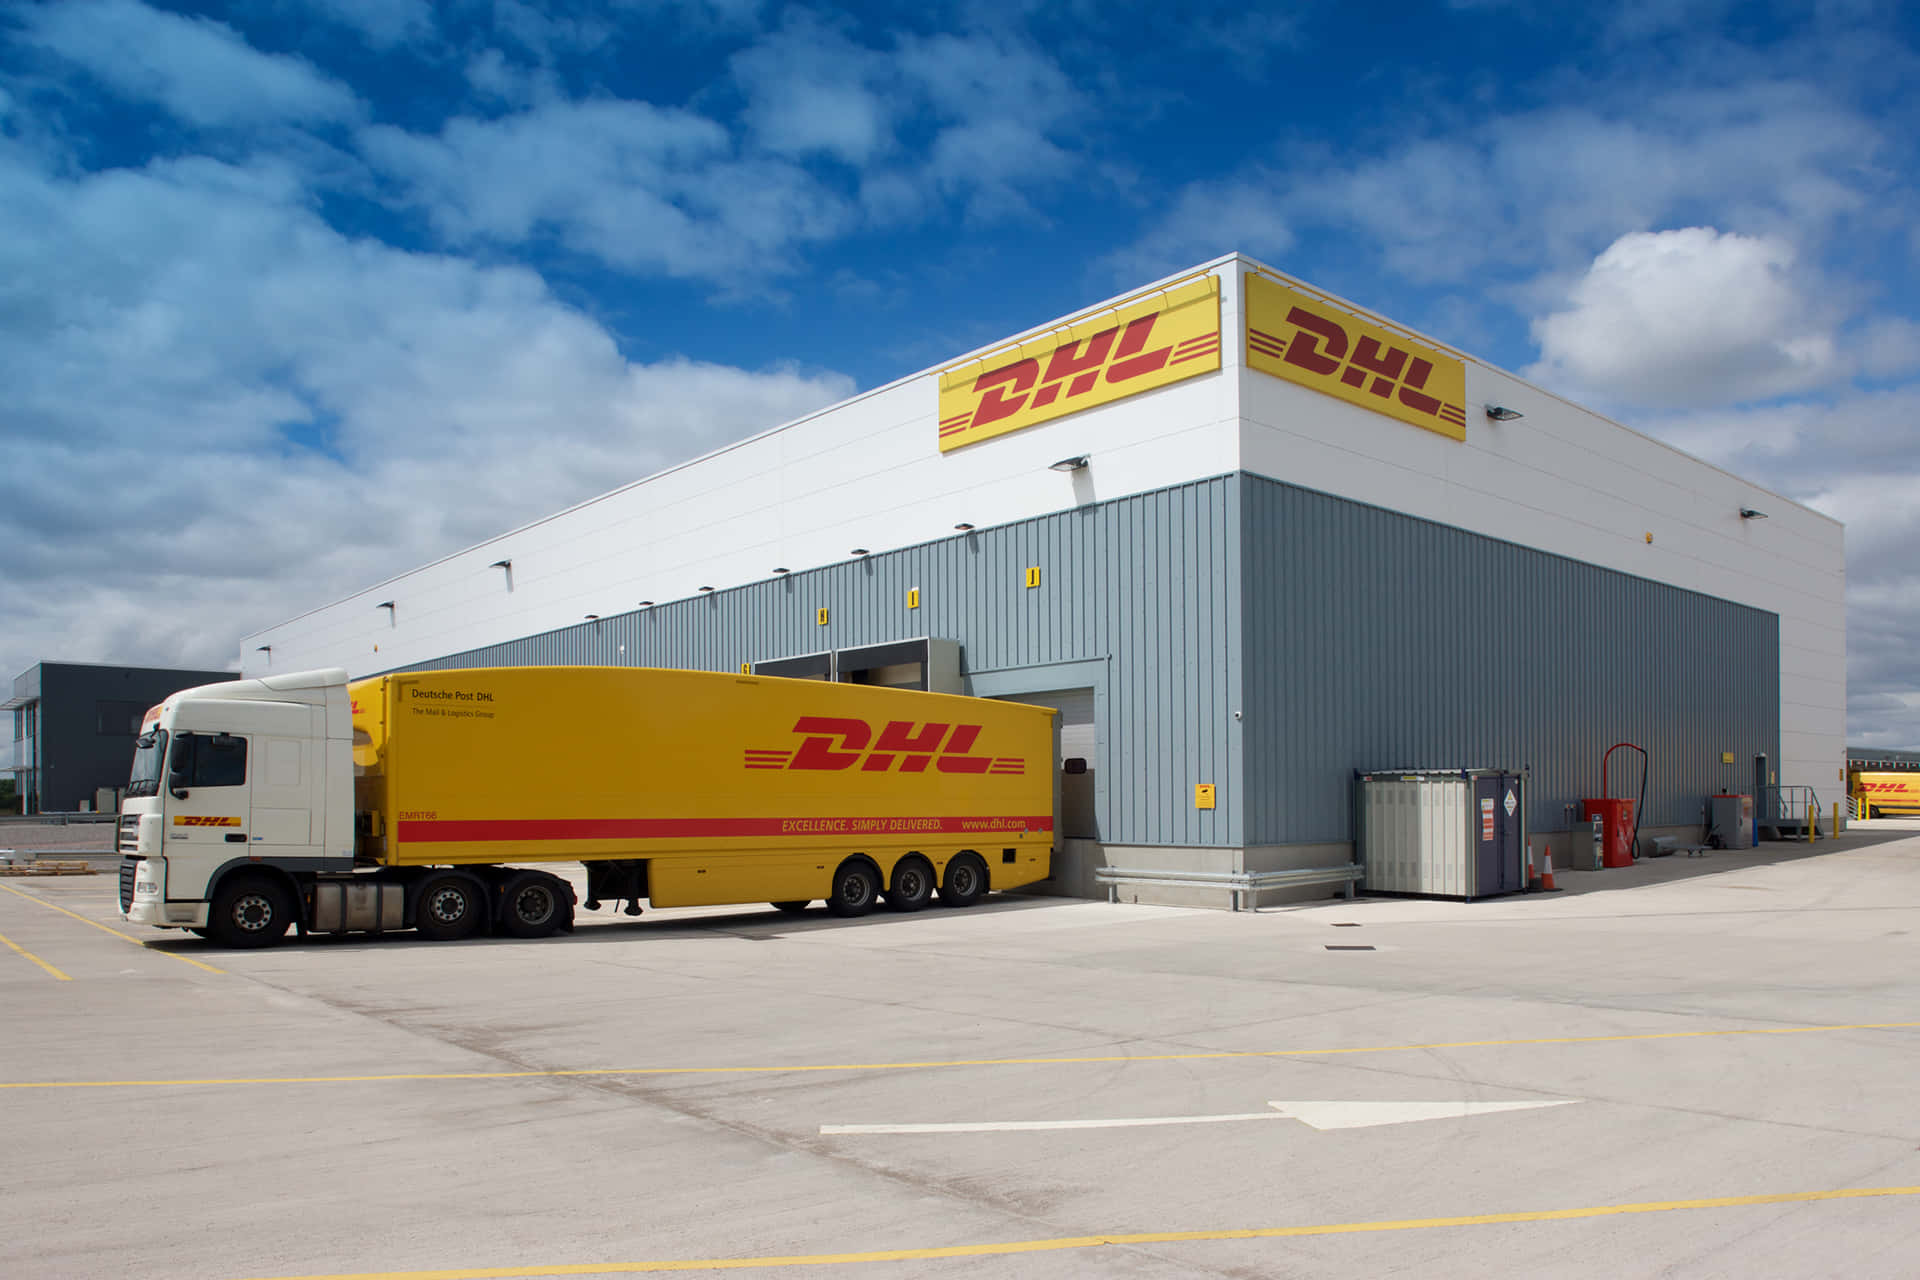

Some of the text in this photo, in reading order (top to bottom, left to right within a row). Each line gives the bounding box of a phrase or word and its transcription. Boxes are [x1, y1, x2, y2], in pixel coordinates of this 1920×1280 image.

[1283, 306, 1442, 417] DHL
[970, 311, 1174, 429] DHL
[412, 688, 495, 702] Deutsche Post DHL
[412, 707, 424, 715] The
[426, 708, 440, 716] Mail
[441, 709, 447, 717] &
[447, 710, 474, 719] Logistics
[788, 716, 993, 774] DHL
[1859, 783, 1909, 792] DHL
[183, 816, 232, 826] DHL
[782, 818, 1027, 832] EXCELLENCE. SIMPLY DELIVERED. www.dhl.com
